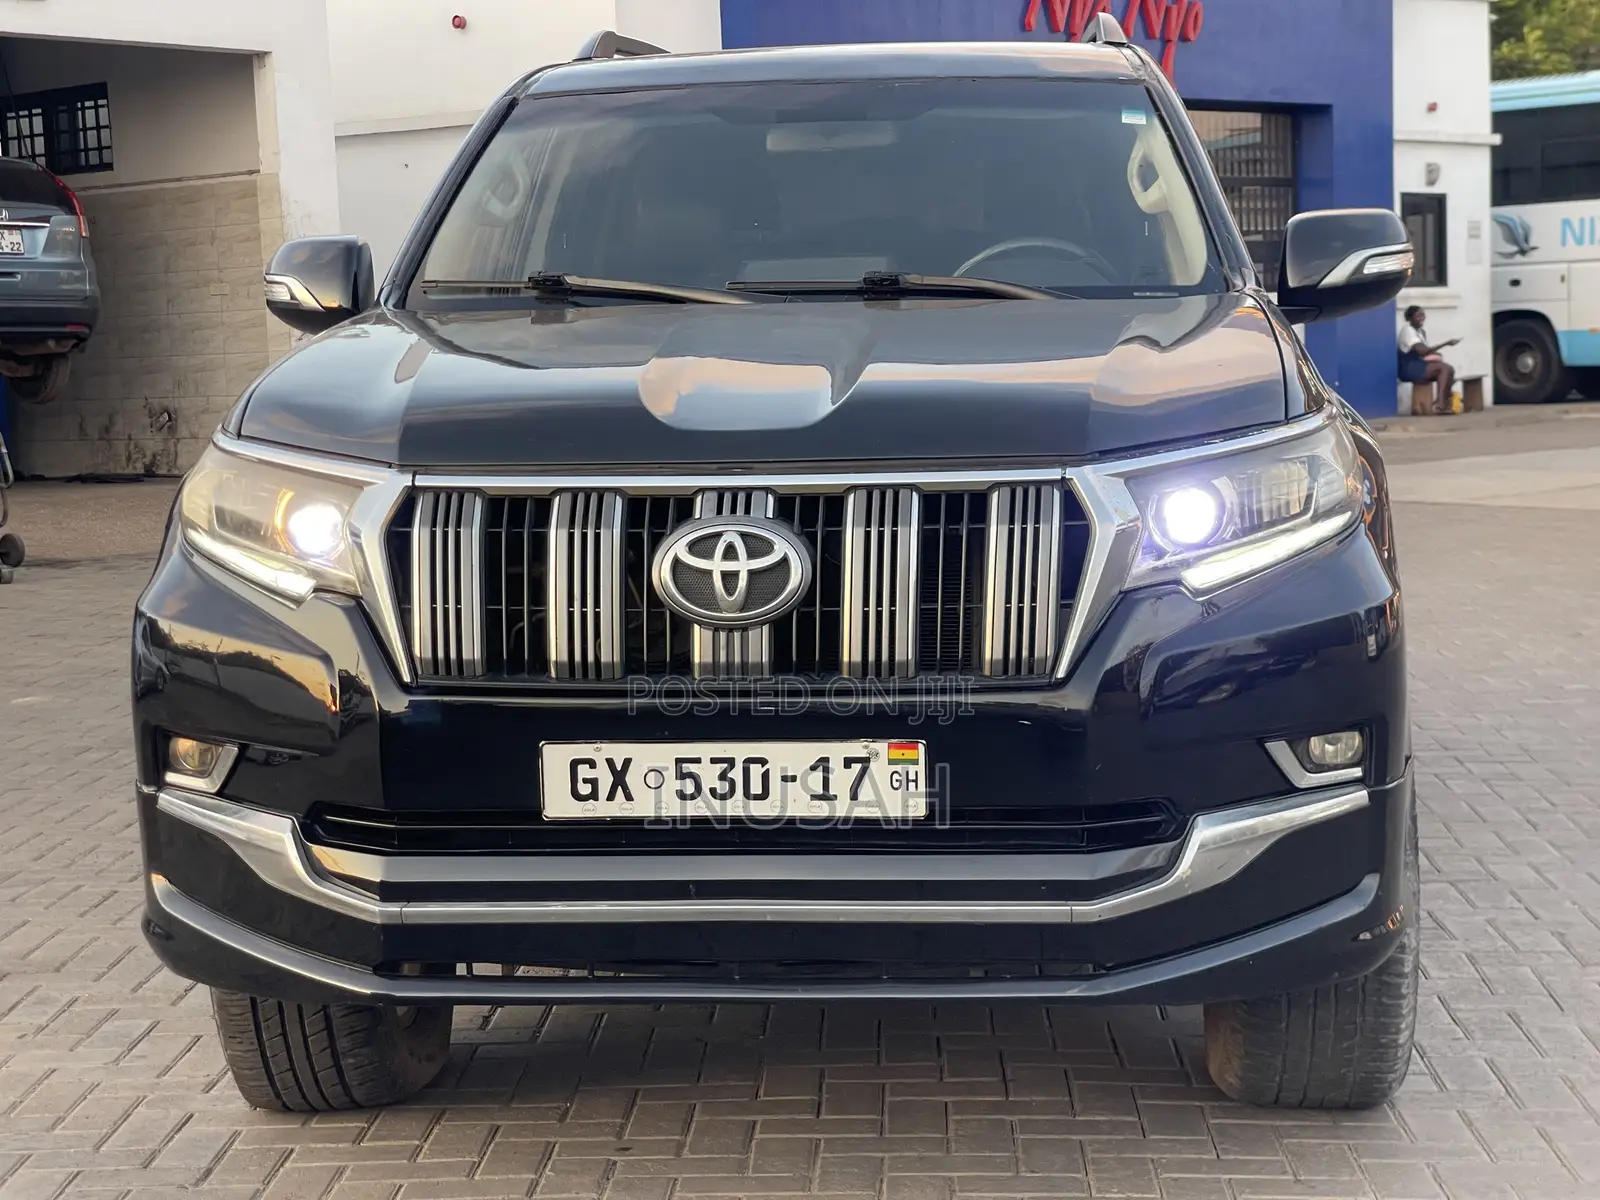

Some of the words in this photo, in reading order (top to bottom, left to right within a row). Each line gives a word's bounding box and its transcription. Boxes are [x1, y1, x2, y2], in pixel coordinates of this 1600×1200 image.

[1560, 216, 1600, 247] NI
[569, 757, 634, 801] GX
[674, 757, 871, 801] 530-17
[890, 770, 918, 791] GH
